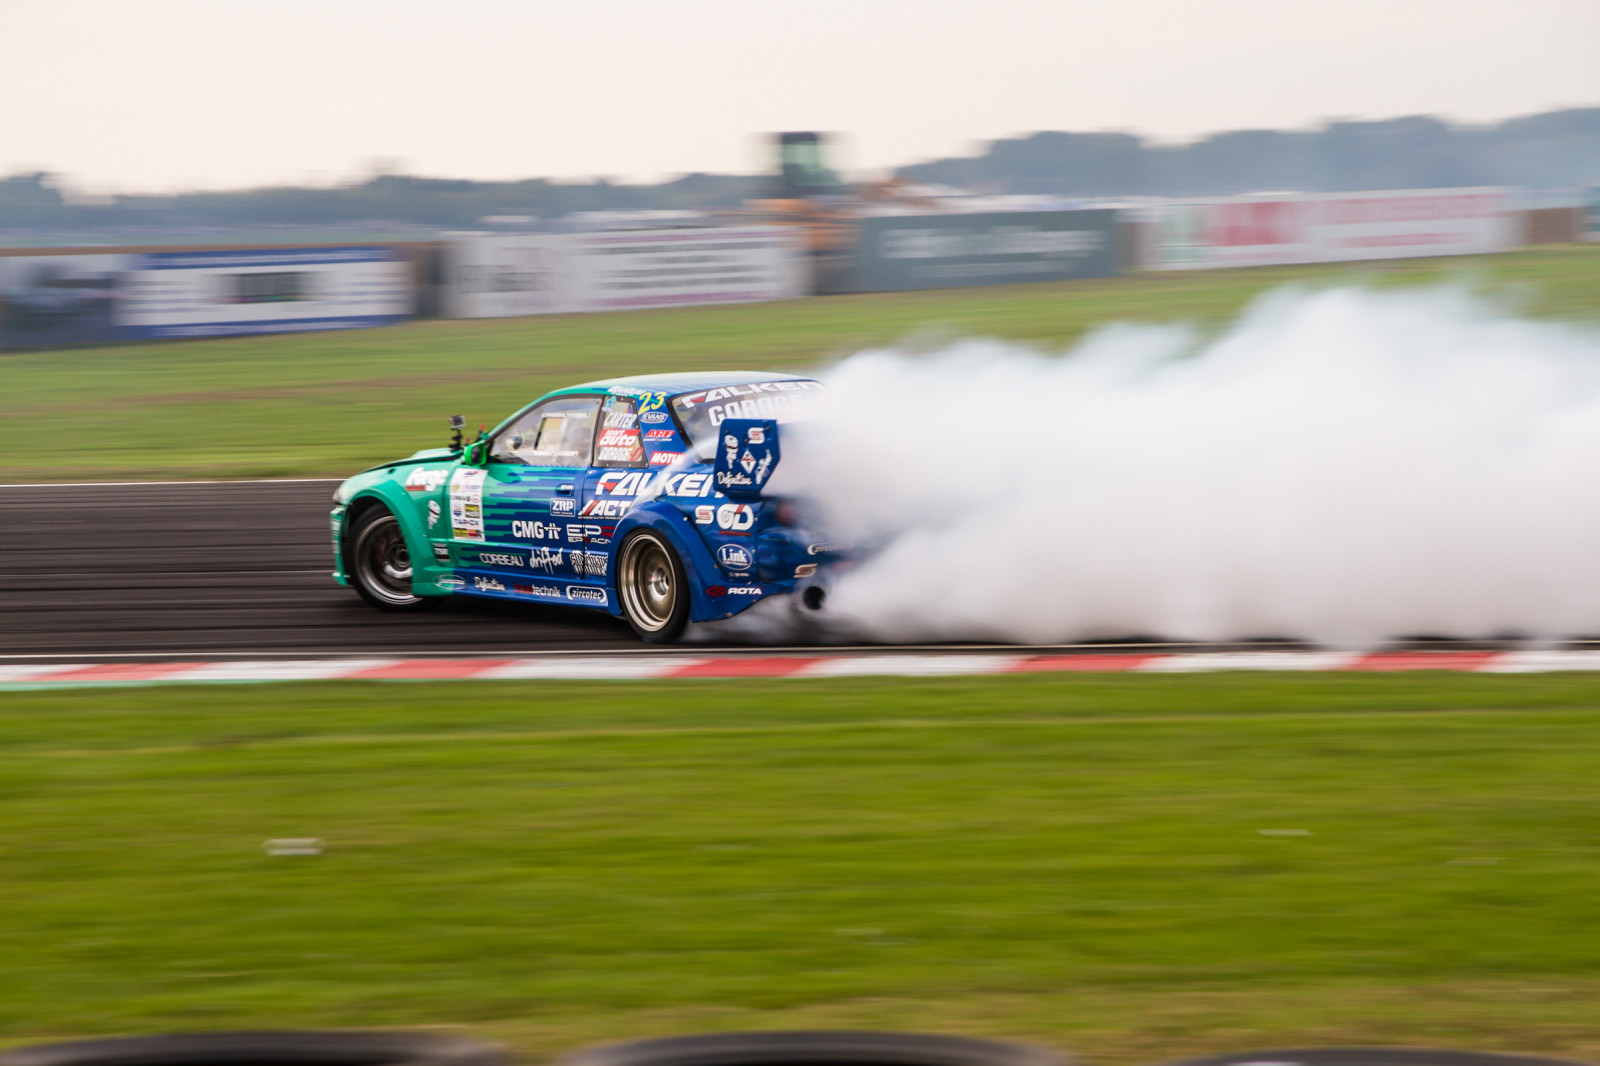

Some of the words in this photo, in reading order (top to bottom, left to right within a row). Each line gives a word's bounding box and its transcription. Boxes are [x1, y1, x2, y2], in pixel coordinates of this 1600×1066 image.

[638, 391, 667, 415] 23
[599, 434, 637, 447] auto
[645, 430, 675, 438] ARP
[552, 500, 573, 511] ZRP
[512, 520, 545, 539] CMG
[479, 552, 524, 567] CORBEAU
[721, 548, 749, 563] Link
[571, 588, 602, 600] zircotec
[728, 587, 762, 595] ROTA
